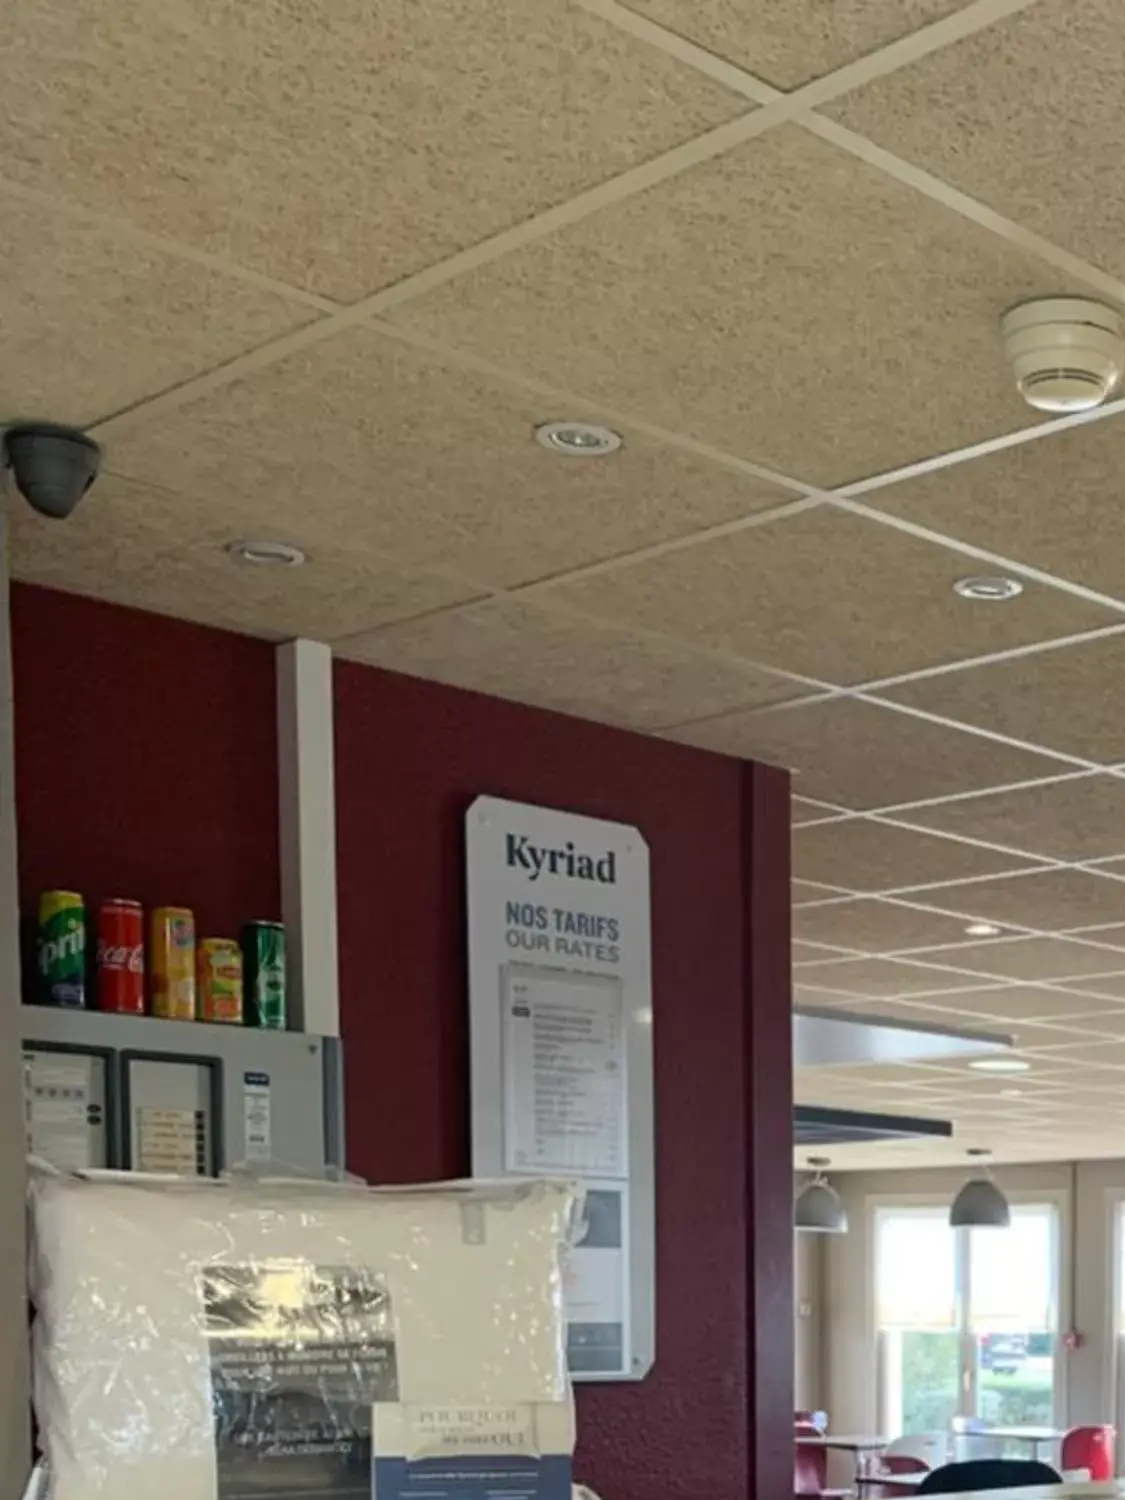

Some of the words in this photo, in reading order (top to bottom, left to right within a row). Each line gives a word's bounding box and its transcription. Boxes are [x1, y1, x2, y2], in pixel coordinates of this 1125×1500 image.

[506, 832, 617, 884] Kyriad
[506, 901, 548, 929] NOS
[553, 908, 620, 942] TARIFS
[505, 929, 550, 953] OUR
[555, 938, 620, 964] RATES
